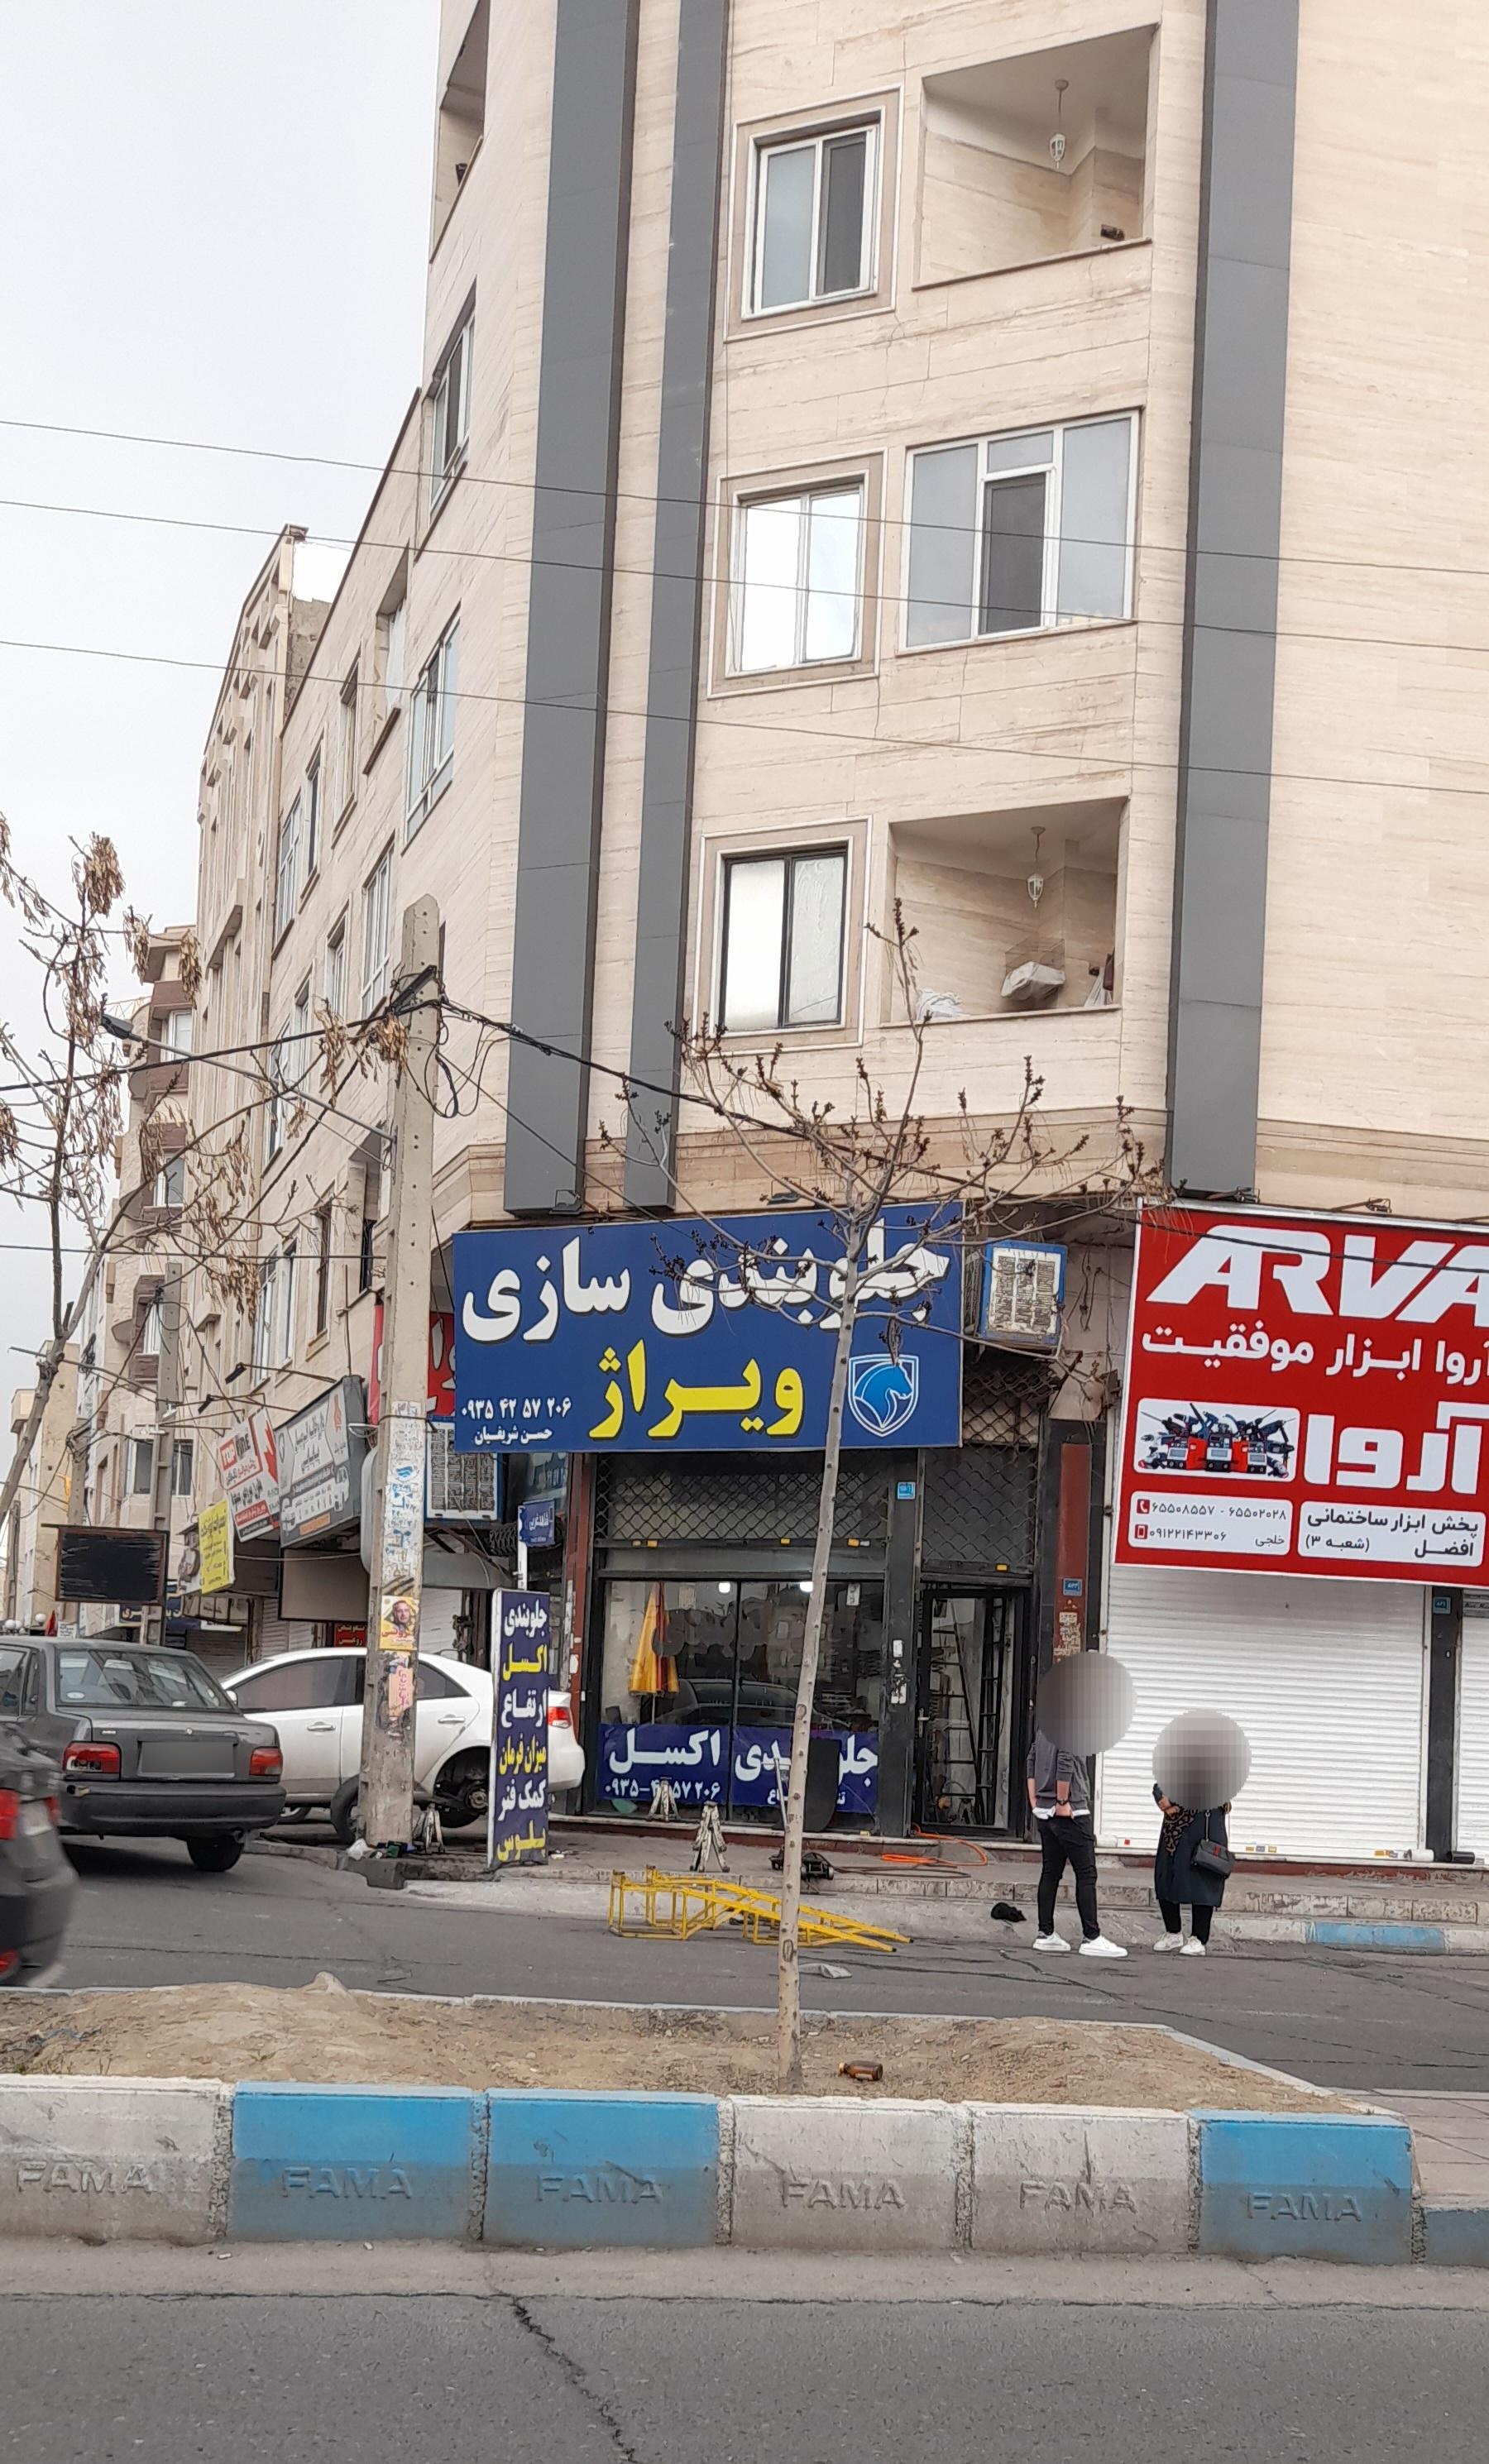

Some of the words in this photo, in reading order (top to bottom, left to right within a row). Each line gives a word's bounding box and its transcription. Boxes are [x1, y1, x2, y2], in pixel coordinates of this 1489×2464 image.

[462, 1236, 630, 1342] سازی
[650, 1218, 950, 1335] جلوبندی
[1142, 1320, 1314, 1372] موفقیت
[1326, 1332, 1423, 1381] ابزار
[1435, 1339, 1489, 1385] روا
[588, 1339, 805, 1439] ویراژ
[474, 1424, 519, 1446] شریفیان
[520, 1428, 553, 1444] حسن
[1304, 1401, 1489, 1495] آروا
[1151, 1502, 1215, 1516] ۶۵۵۰۸۵۵۷
[1228, 1507, 1287, 1520] ۶۵۵۰۲۰۲۸
[1307, 1508, 1388, 1527] ساختمانی
[1391, 1513, 1425, 1533] ابزار
[1432, 1514, 1478, 1539] پخش
[1255, 1534, 1285, 1548] خلجی
[1415, 1538, 1473, 1558] افضل
[504, 1600, 548, 1637] جلوبندی
[502, 1642, 548, 1681] اکسل
[500, 1687, 548, 1729] ارتفاع
[499, 1732, 524, 1775] فرمان
[523, 1735, 547, 1773] میزان
[609, 1727, 721, 1775] اکسل
[735, 1734, 879, 1787] جلدی
[497, 1778, 516, 1821] فنر
[518, 1778, 548, 1810] کمک
[496, 1820, 547, 1862] پلوس
[17, 2159, 154, 2194] FAMA
[281, 2165, 413, 2201] FAMA
[536, 2173, 663, 2204] FAMA
[780, 2178, 906, 2211] FAMA
[1246, 2192, 1362, 2222] FAMA
